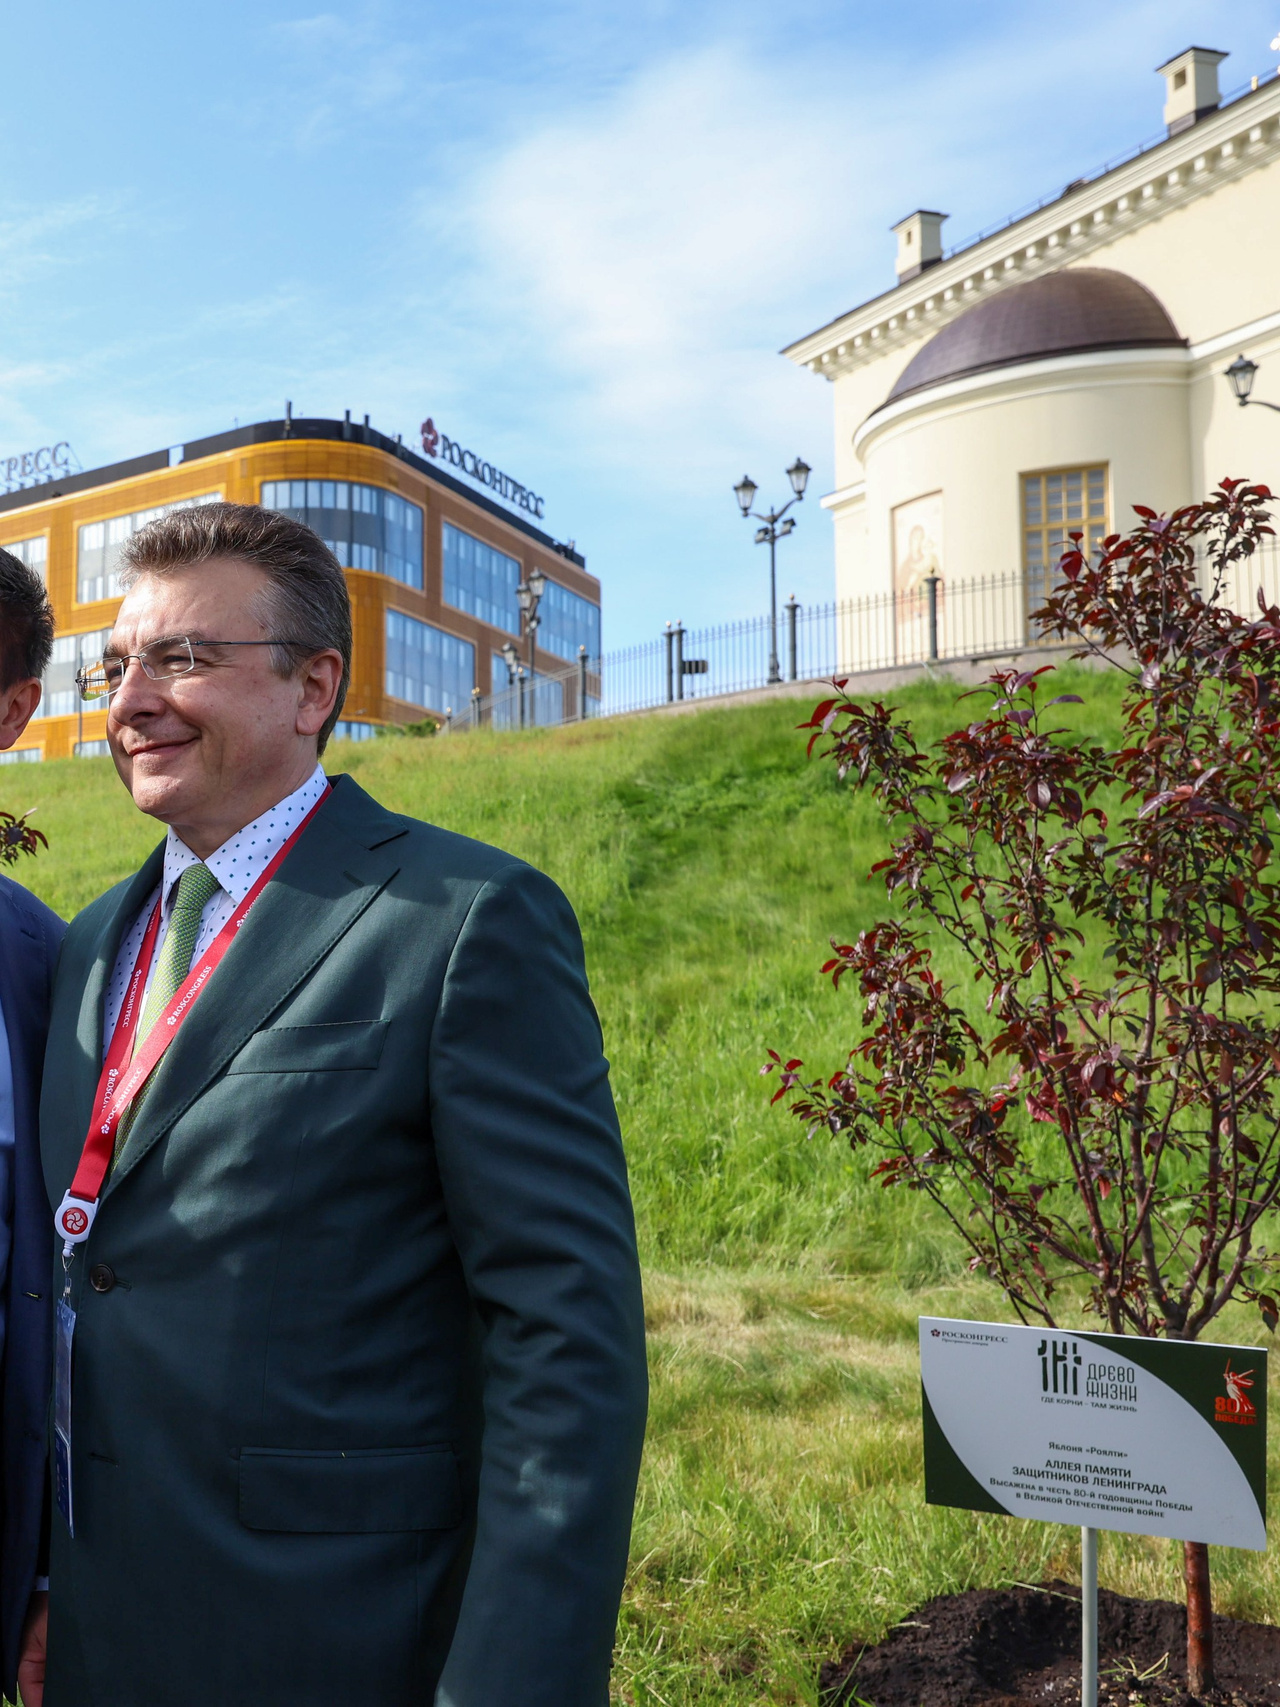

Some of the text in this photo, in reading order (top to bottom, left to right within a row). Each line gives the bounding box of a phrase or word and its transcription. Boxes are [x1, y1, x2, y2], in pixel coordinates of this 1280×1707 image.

[441, 434, 544, 519] РОСКОНГРЕСС
[122, 975, 141, 1028] РОСКОНГРЕСС
[173, 965, 213, 1017] ROSCONGRESS
[105, 1067, 142, 1125] РОСКОНГРЕСС
[942, 1330, 1009, 1344] РОСКОНГРЕСС
[1087, 1363, 1135, 1384] ДРЕВО
[1041, 1396, 1055, 1404] ГДЕ
[1056, 1398, 1083, 1407] КОРНИ
[1090, 1401, 1108, 1409] ТАМ
[1108, 1403, 1138, 1413] ЖИЗНЬ
[1012, 1466, 1168, 1495] ЗАЩИТНИКОВ ЛЕНИНГРАДА
[1045, 1459, 1132, 1479] АЛЛЕЯ ПАМЯТИ
